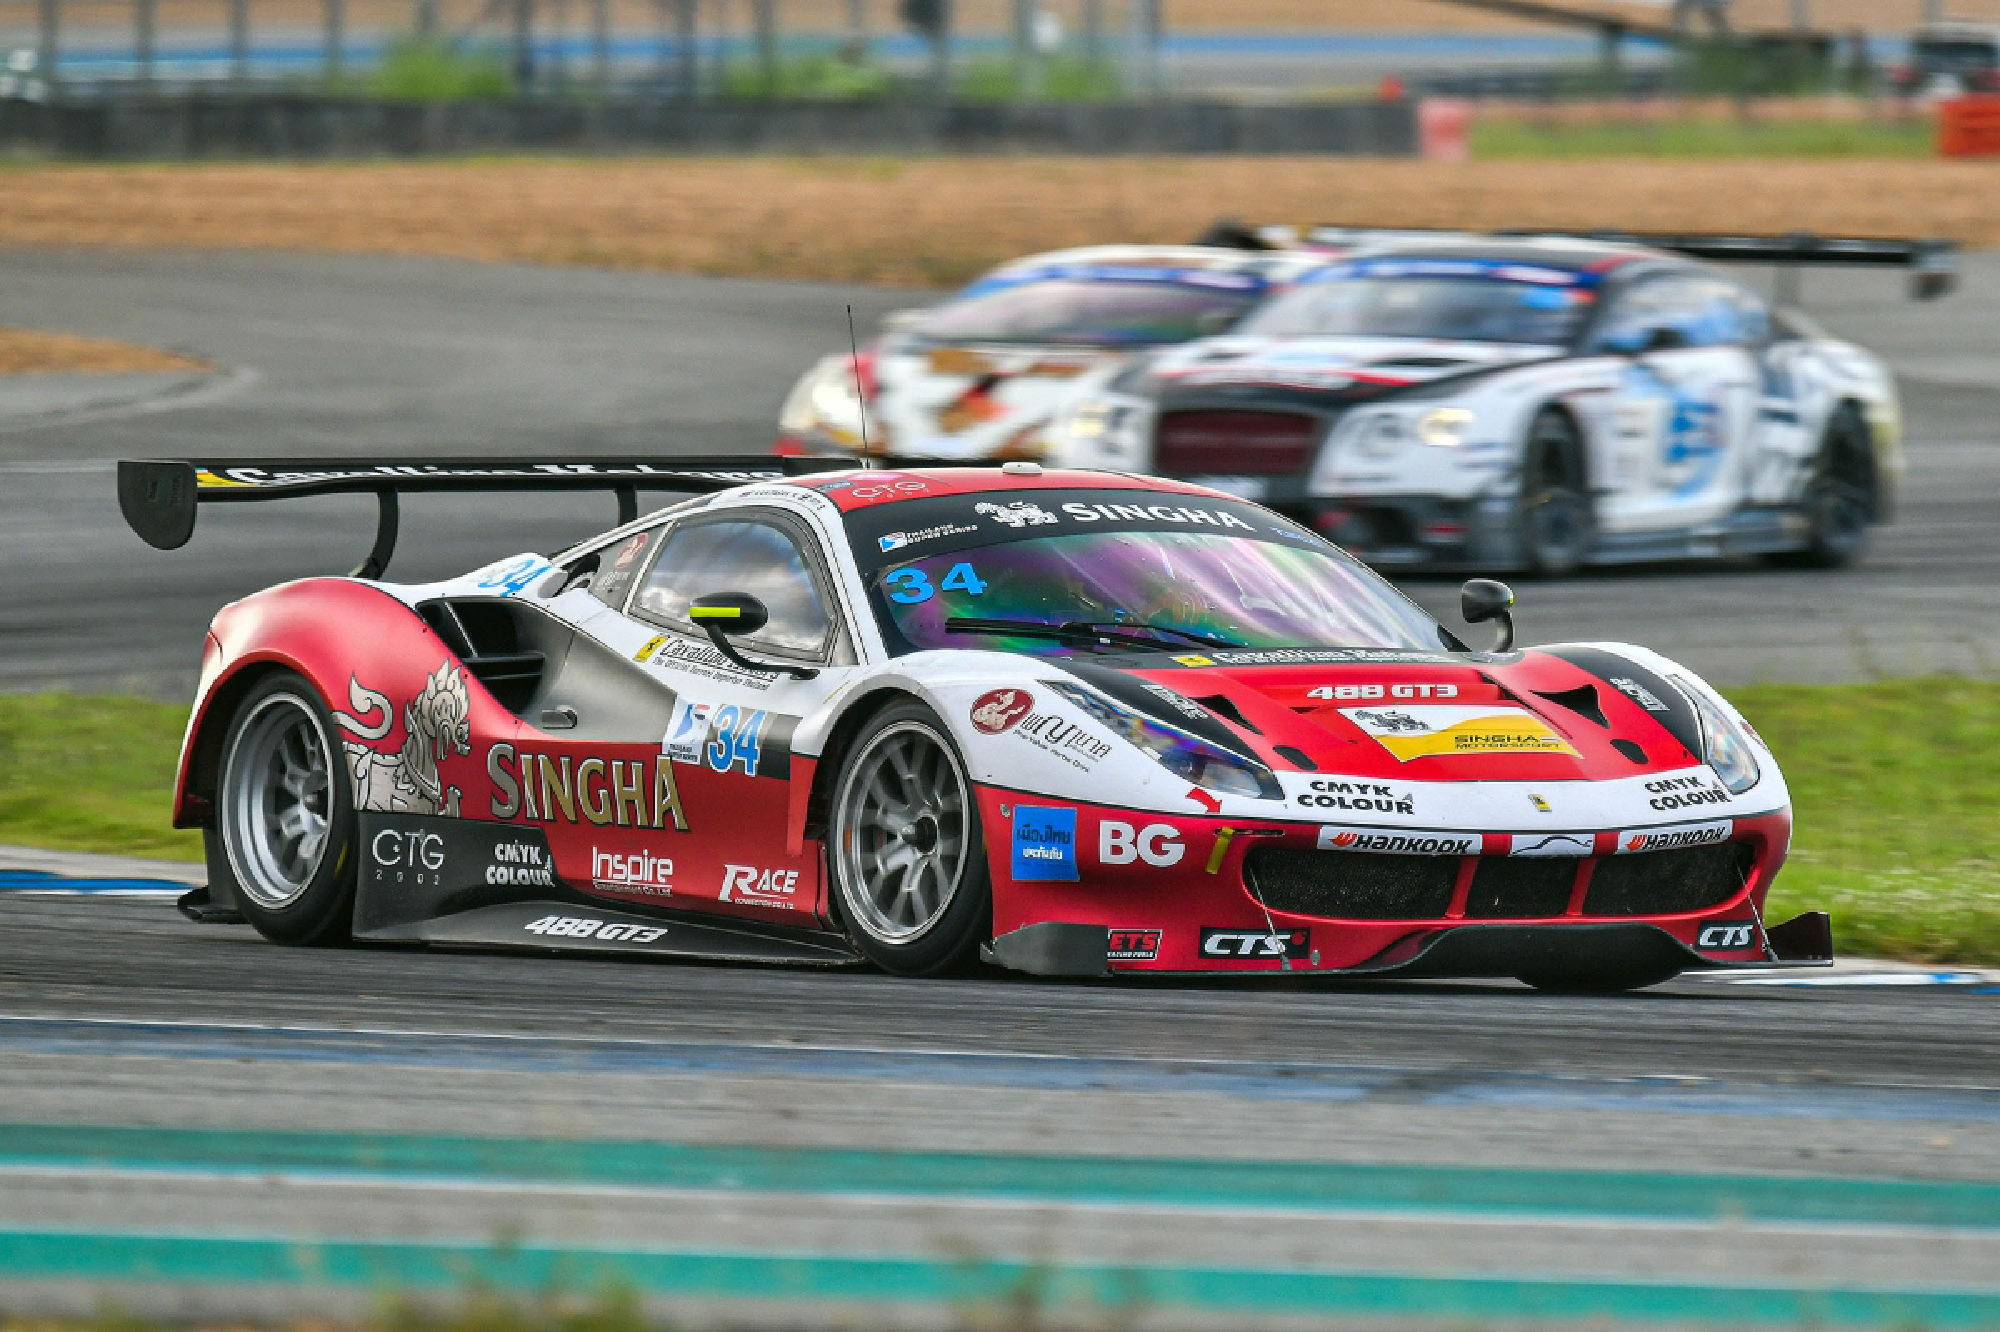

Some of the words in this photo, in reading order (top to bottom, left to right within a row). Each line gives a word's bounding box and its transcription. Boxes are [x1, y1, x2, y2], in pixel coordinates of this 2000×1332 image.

[1062, 503, 1257, 532] SINGHA
[886, 562, 988, 605] 34
[1306, 684, 1385, 700] 488
[1390, 684, 1458, 698] GT3
[707, 703, 769, 777] 34
[1454, 734, 1539, 743] SINGHA
[487, 743, 691, 833] SINGHA
[1310, 781, 1393, 797] CMYK
[1645, 776, 1707, 793] CMYK
[1297, 794, 1415, 815] COLOUR
[1650, 789, 1732, 811] COLOUR
[494, 843, 542, 865] CMYK
[1099, 820, 1186, 867] BG
[485, 865, 556, 887] COLOUR
[592, 846, 674, 885] Inspire
[717, 864, 799, 903] RACE
[525, 916, 603, 938] 488
[596, 923, 669, 944] GT3
[1700, 926, 1754, 946] CTS
[1109, 933, 1158, 951] ETS
[1204, 934, 1293, 956] CTS
